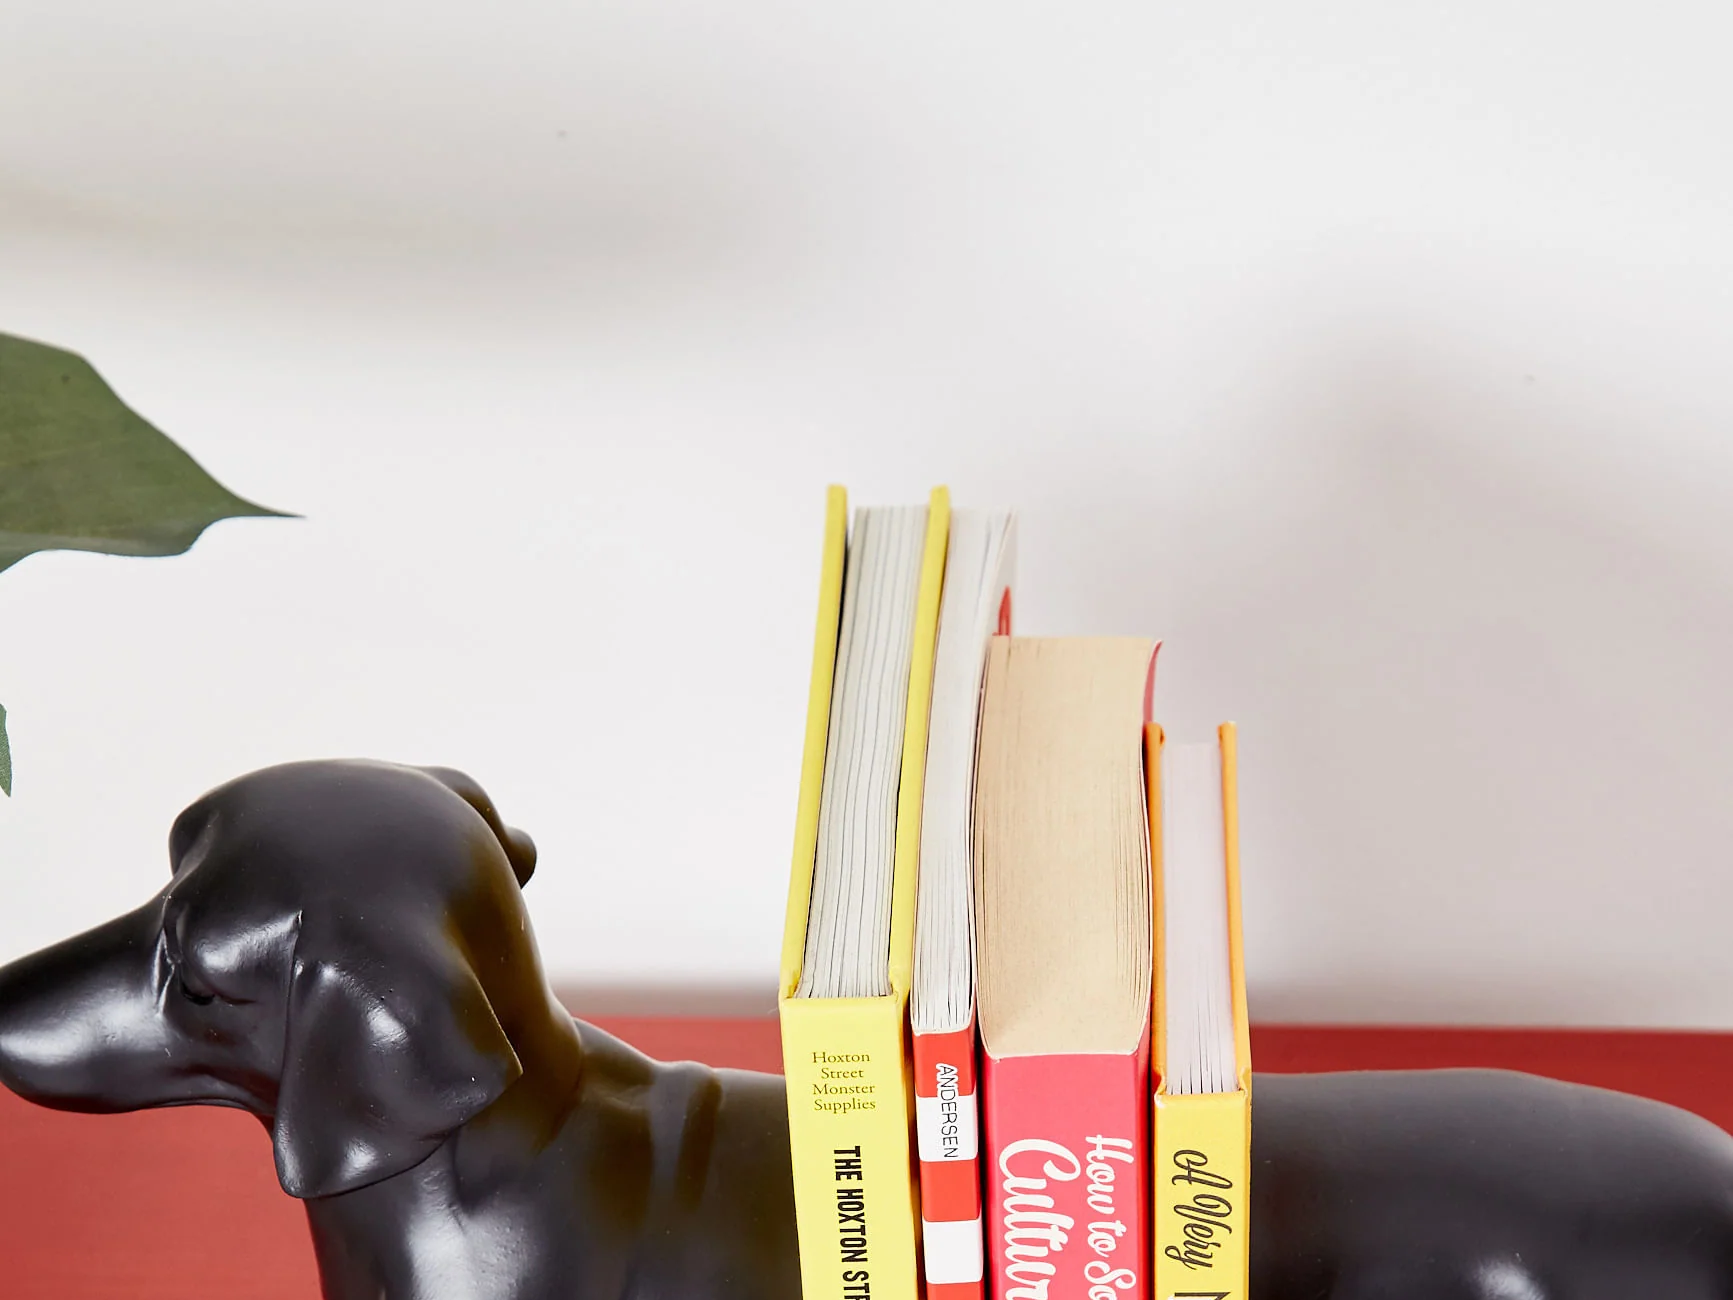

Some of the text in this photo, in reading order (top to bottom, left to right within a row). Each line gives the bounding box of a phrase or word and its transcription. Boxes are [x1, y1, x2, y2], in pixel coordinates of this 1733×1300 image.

[812, 1051, 870, 1063] Hoxton
[821, 1067, 864, 1079] Street
[812, 1083, 875, 1095] Monster
[814, 1097, 876, 1114] Supplies
[939, 1065, 959, 1158] ANDERSEN
[834, 1145, 863, 1181] THE
[1085, 1134, 1135, 1215] How
[1171, 1149, 1233, 1189] A
[836, 1188, 868, 1263] HOXTON
[1087, 1219, 1127, 1258] to
[1165, 1193, 1233, 1271] Very
